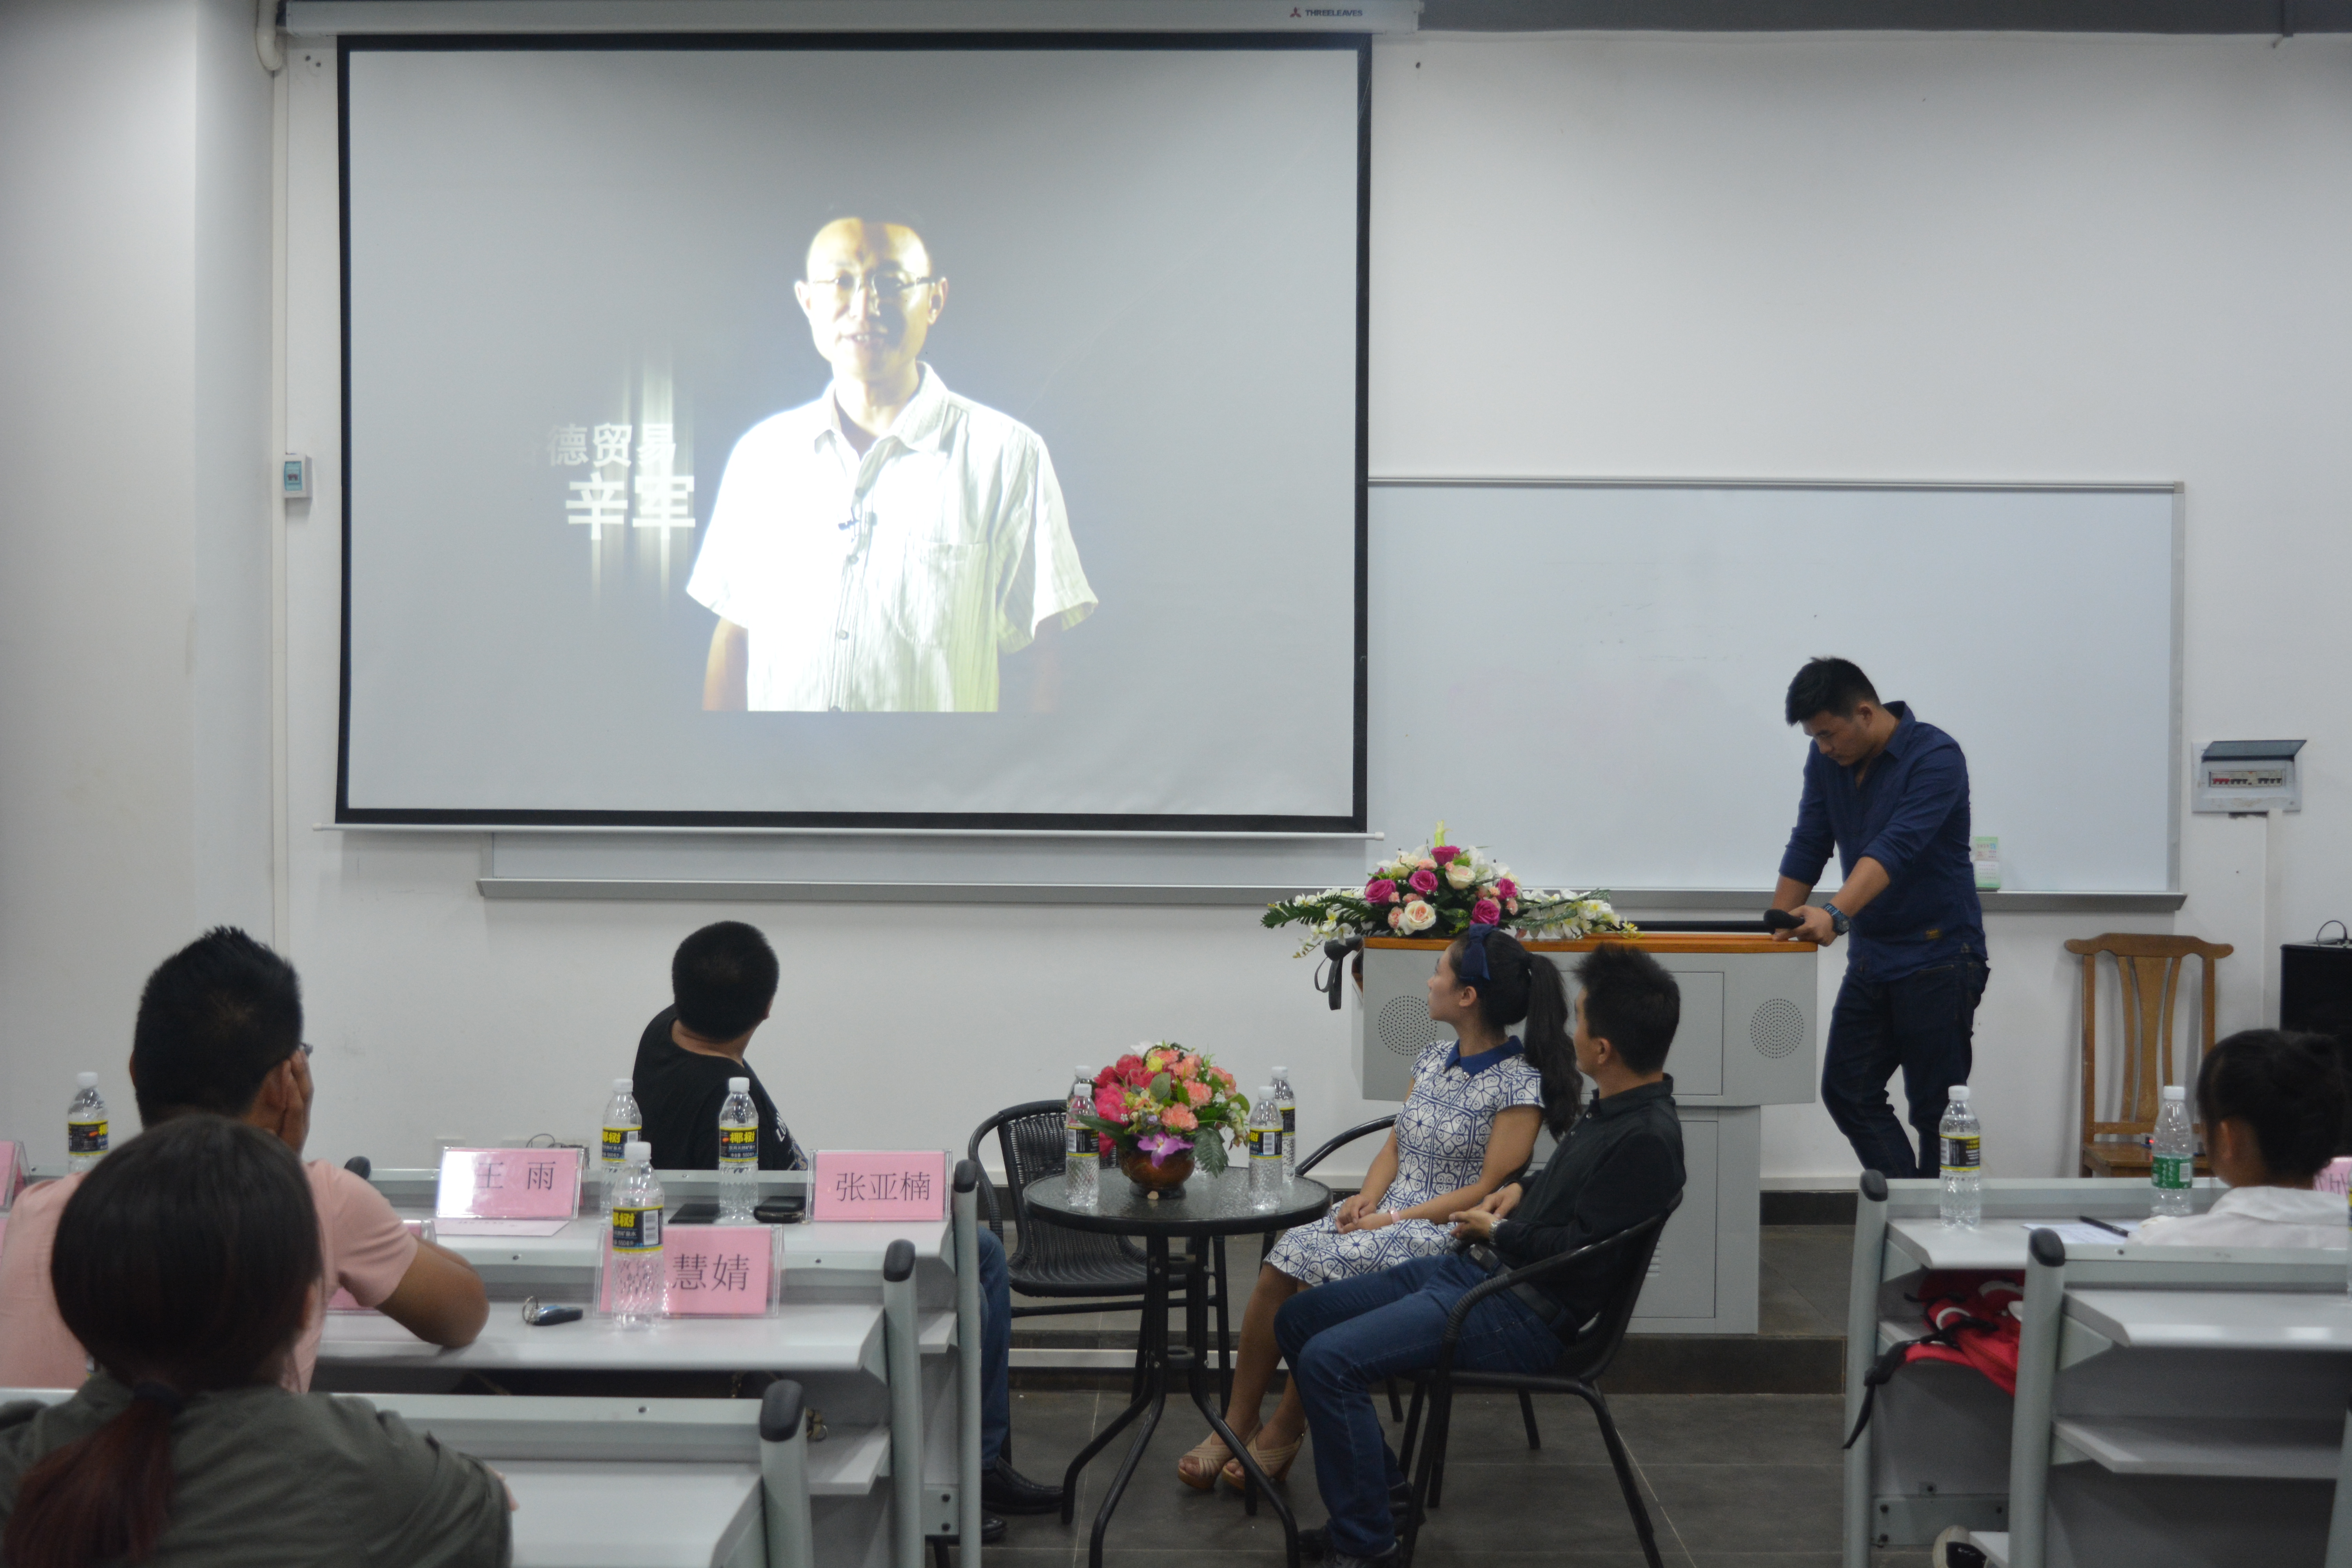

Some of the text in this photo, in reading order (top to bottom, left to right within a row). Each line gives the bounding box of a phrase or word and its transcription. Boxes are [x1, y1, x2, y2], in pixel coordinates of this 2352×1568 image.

[730, 1131, 755, 1143] 椰树
[836, 1171, 931, 1201] 张亚楠
[664, 1254, 750, 1291] 慧婧
